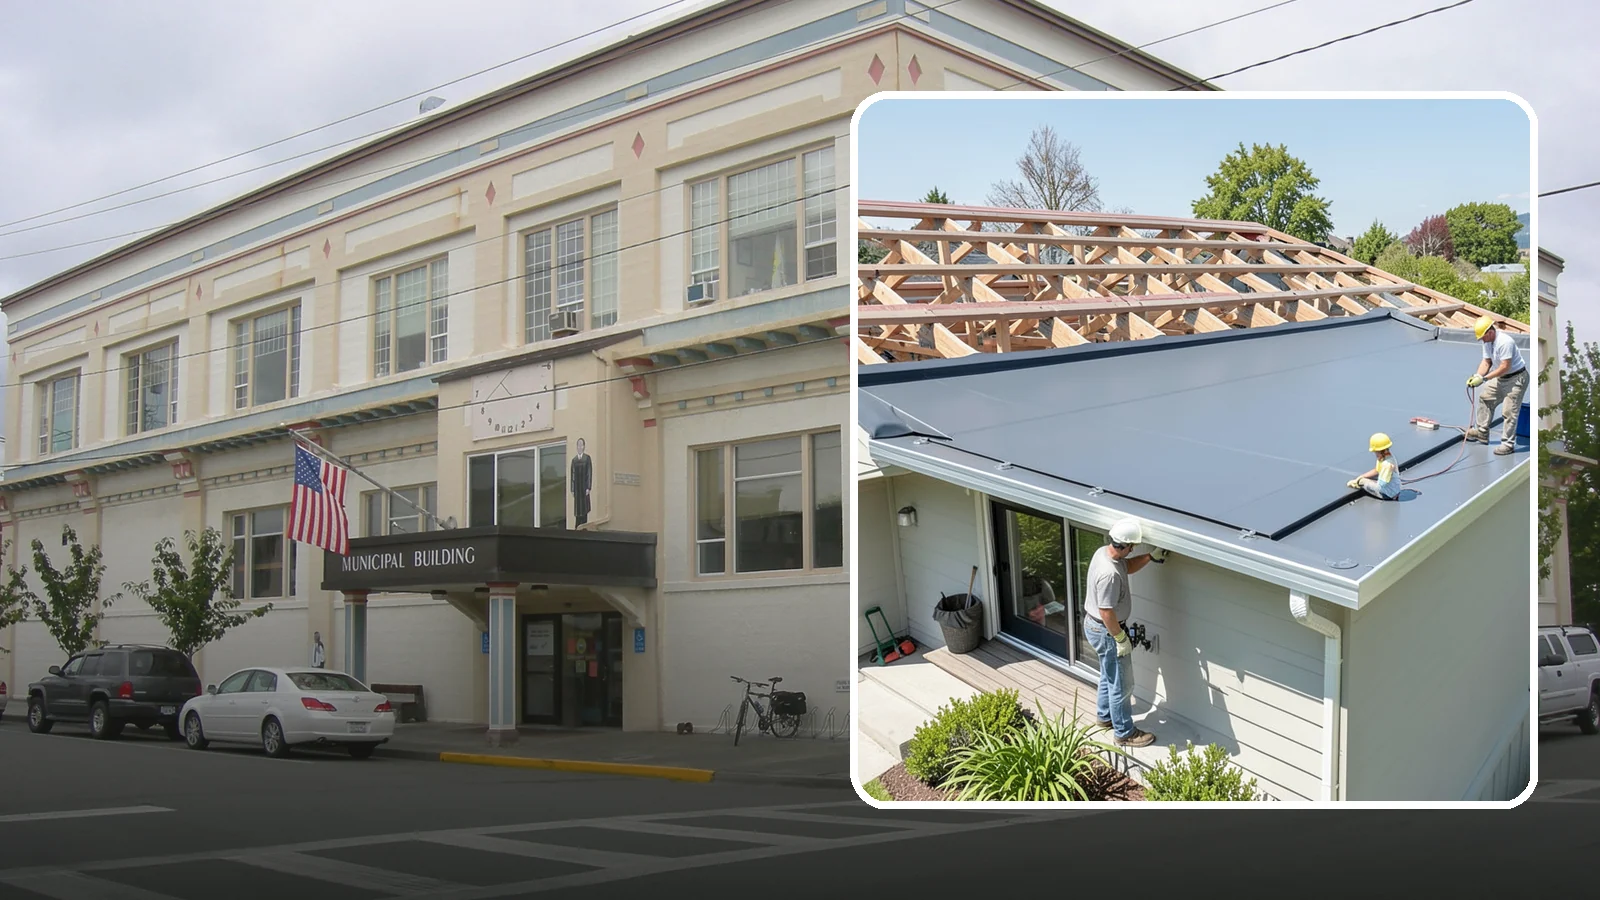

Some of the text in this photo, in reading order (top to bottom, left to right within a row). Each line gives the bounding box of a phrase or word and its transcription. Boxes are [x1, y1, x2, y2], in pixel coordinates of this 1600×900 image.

[529, 414, 532, 422] 3
[342, 546, 475, 572] MUNICIPAL BUILDING
